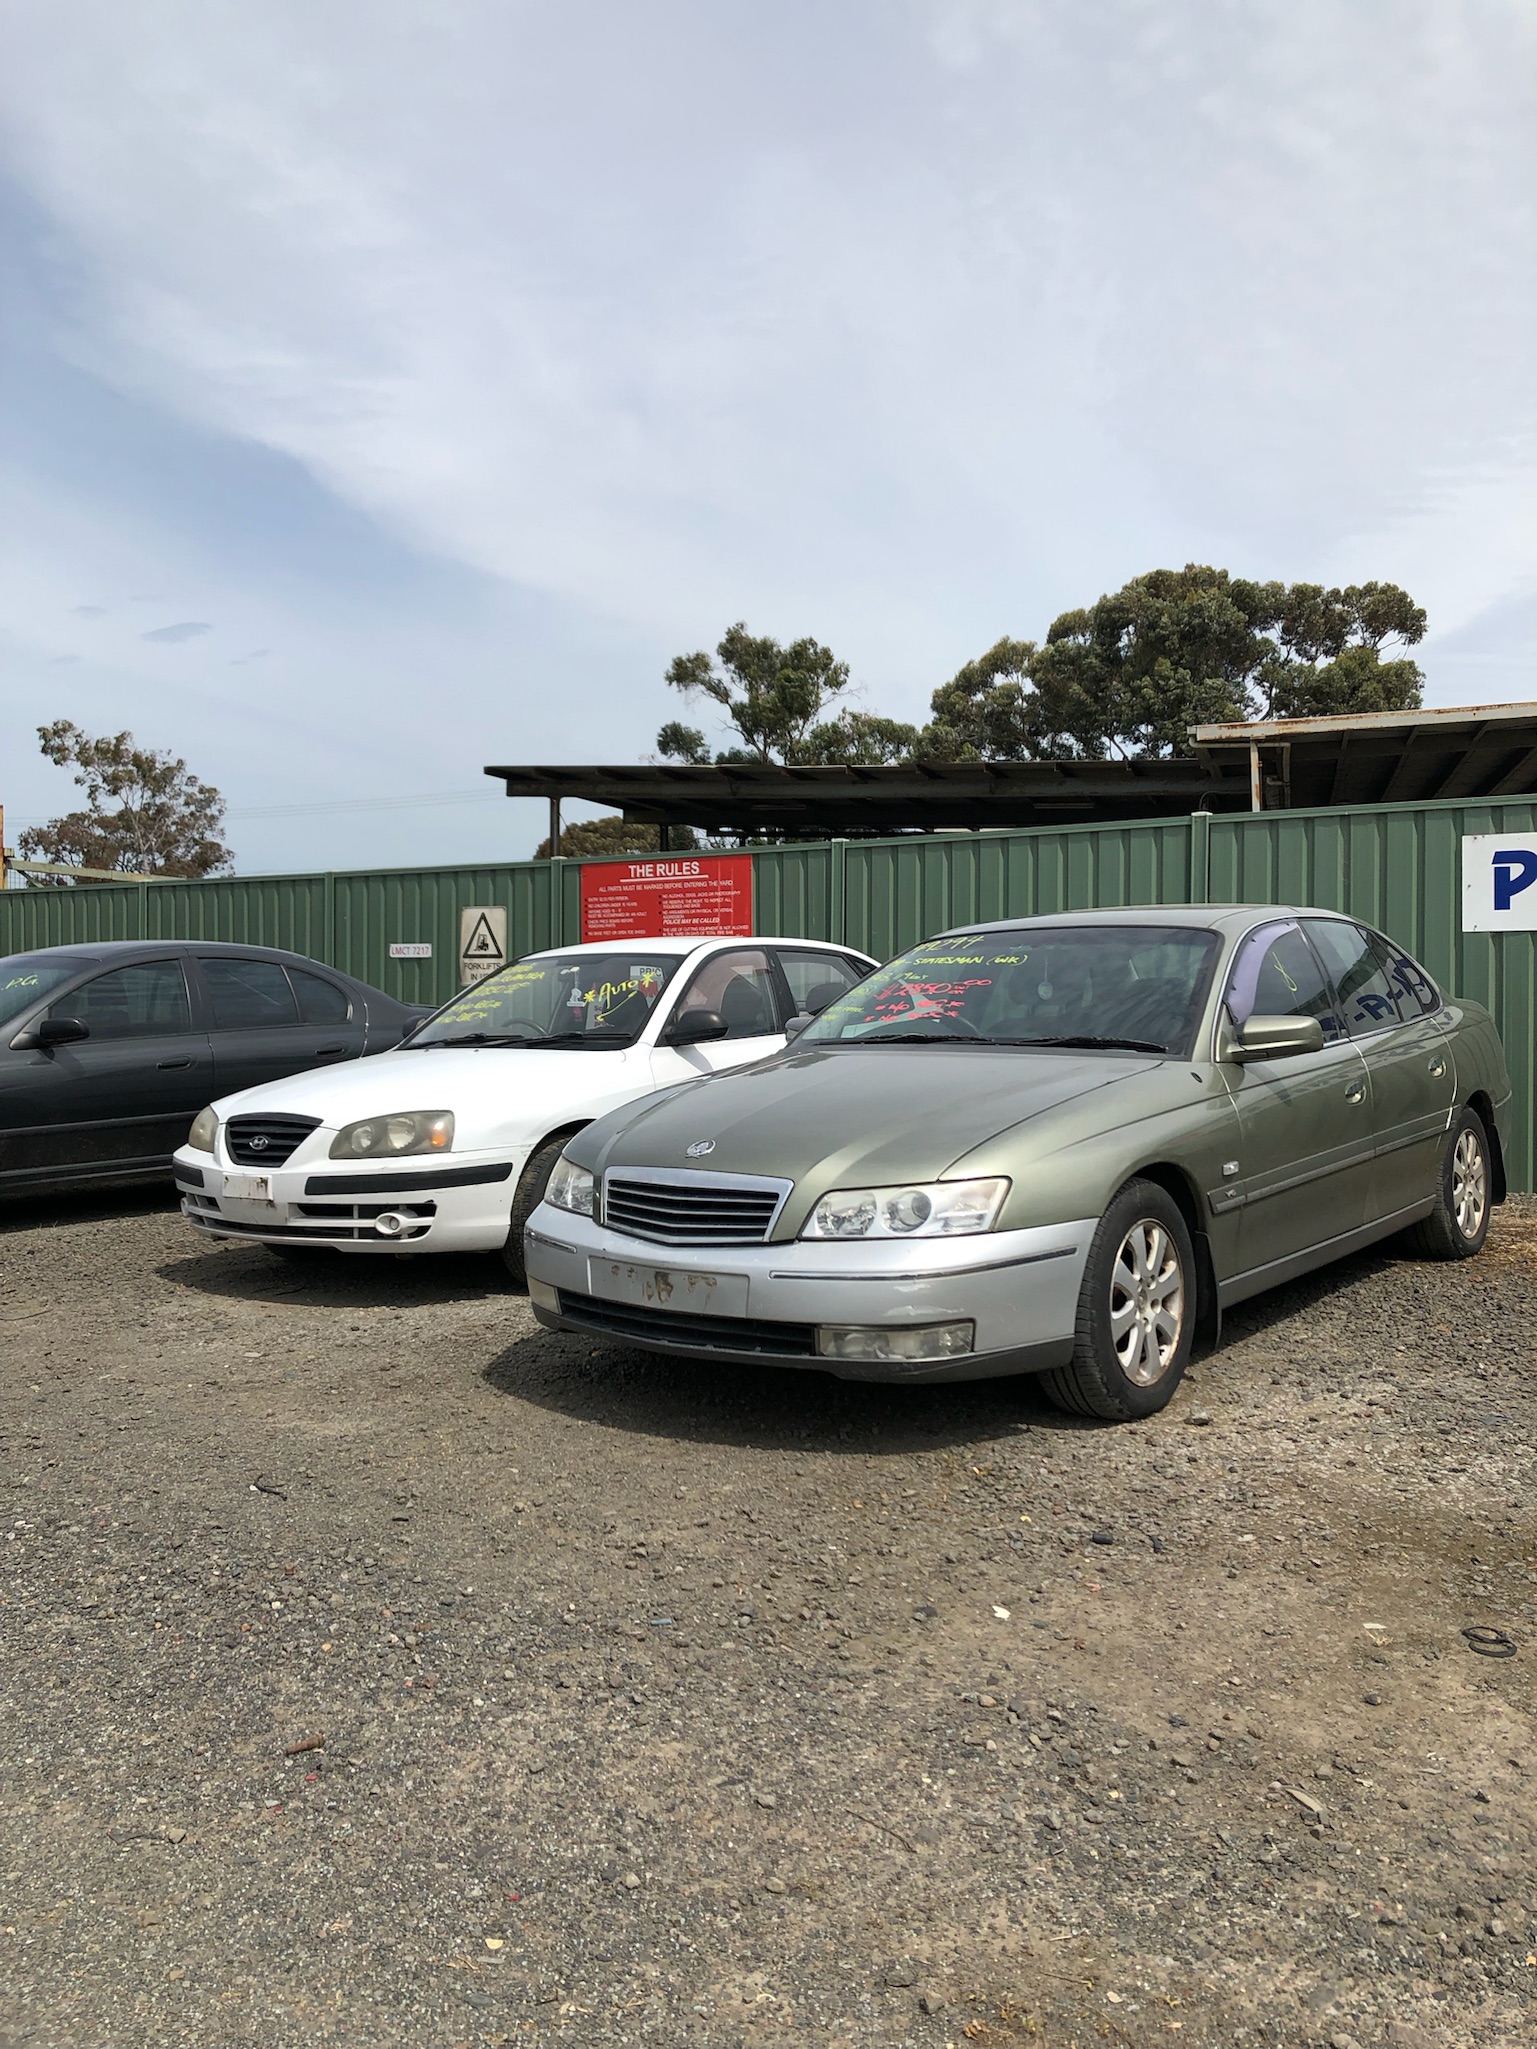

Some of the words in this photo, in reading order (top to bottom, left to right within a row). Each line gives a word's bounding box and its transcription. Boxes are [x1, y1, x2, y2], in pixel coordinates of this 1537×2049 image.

[628, 864, 654, 878] THE
[656, 861, 700, 876] RULES
[719, 879, 734, 887] YARD
[700, 916, 720, 924] CALLED
[391, 946, 411, 955] LMCT
[412, 946, 430, 955] 7217
[463, 962, 501, 970] FORKLIFTS
